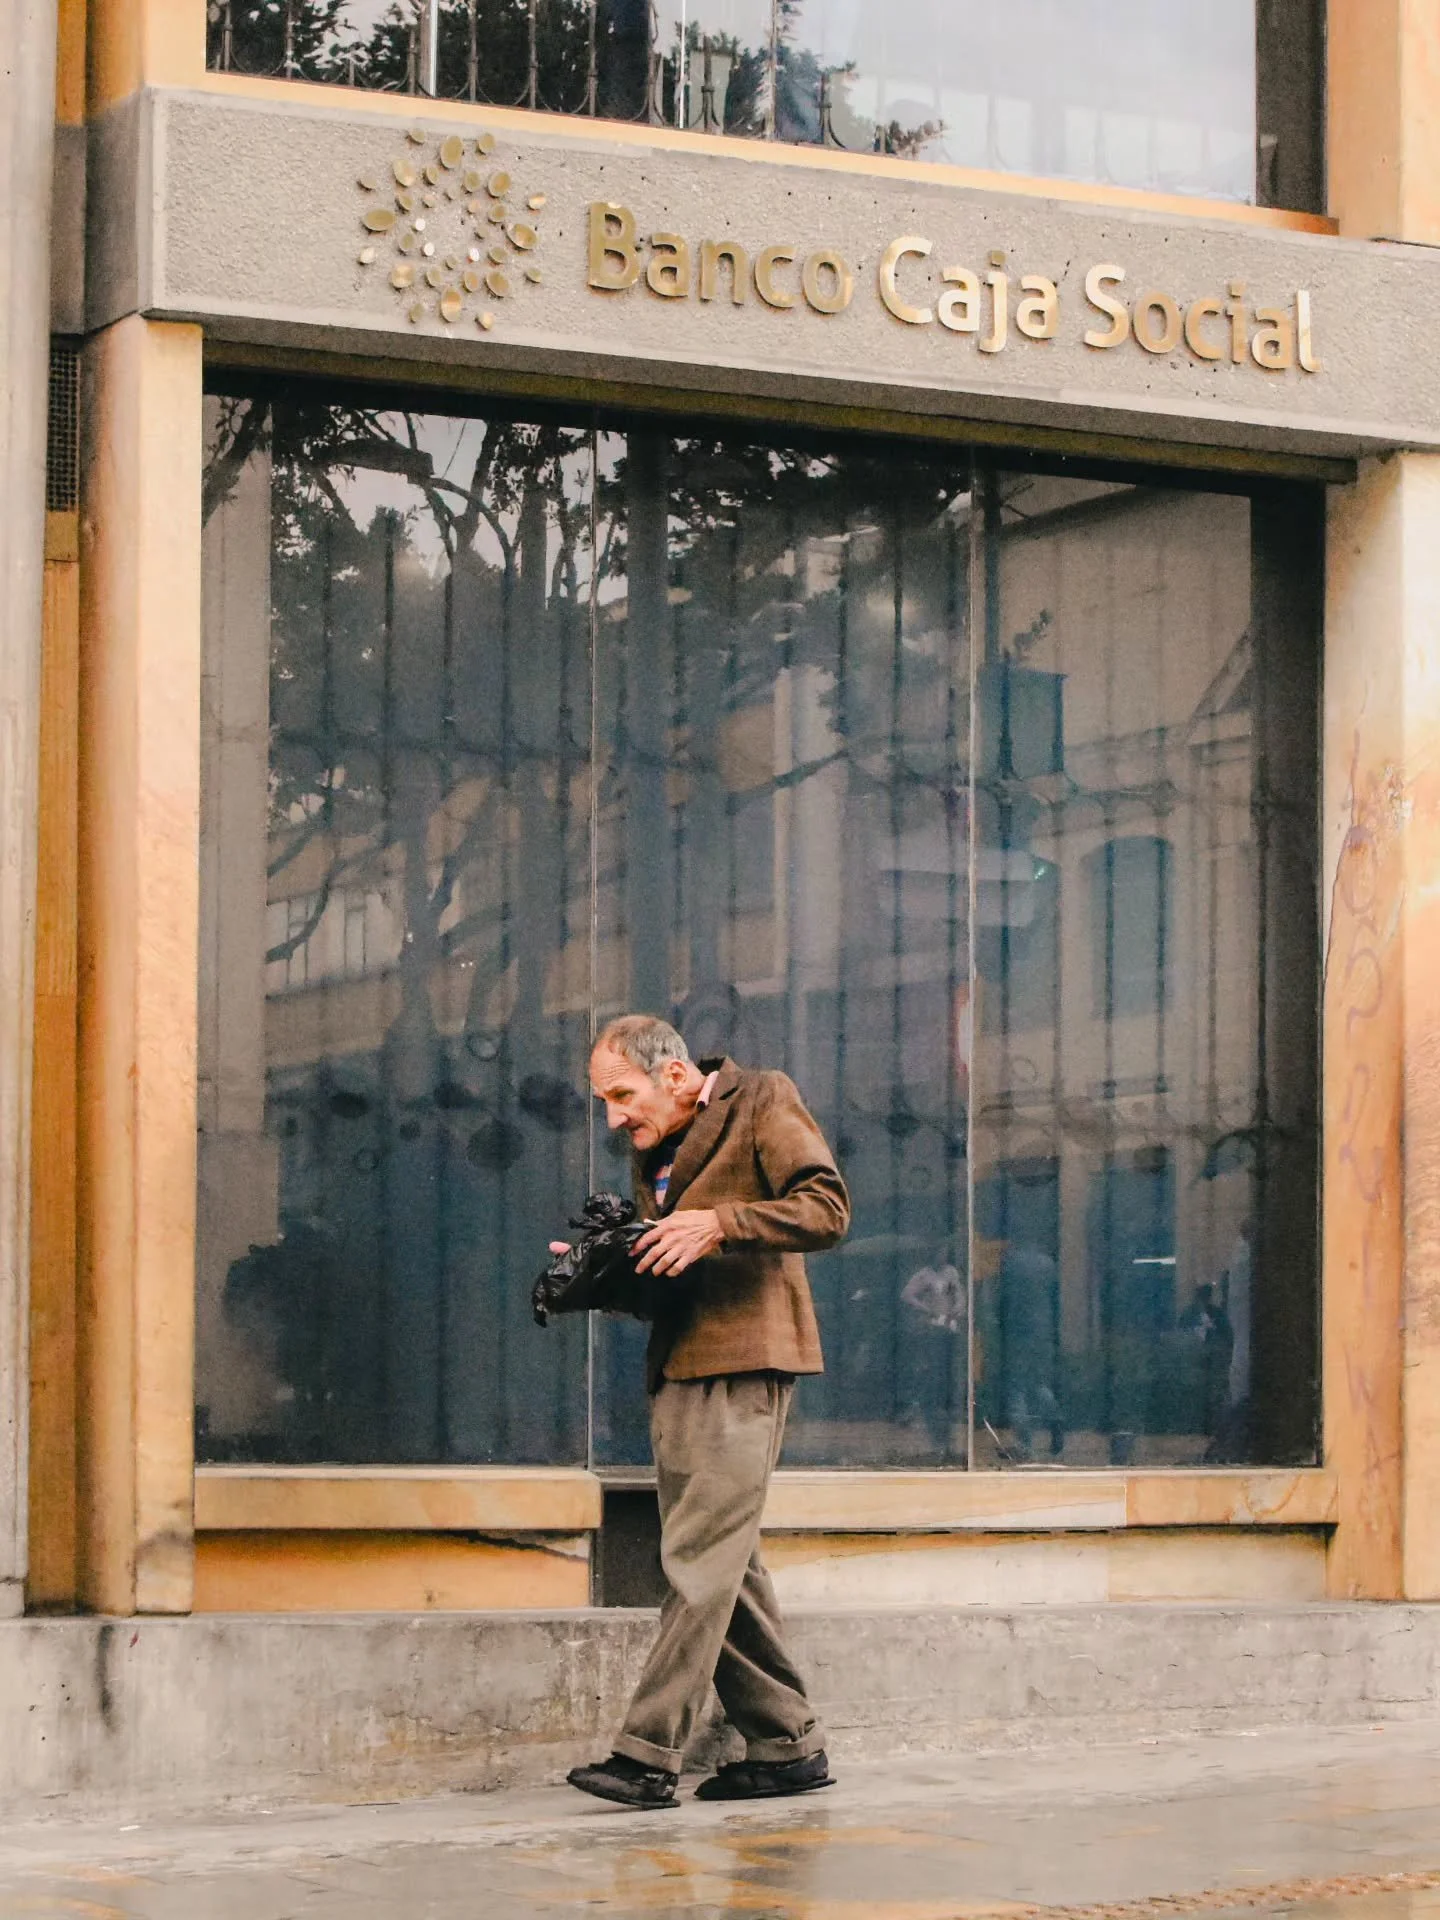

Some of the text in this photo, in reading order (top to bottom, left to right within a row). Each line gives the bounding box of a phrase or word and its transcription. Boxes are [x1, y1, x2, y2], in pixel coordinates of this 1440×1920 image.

[588, 202, 1321, 373] Banco Caja Social
